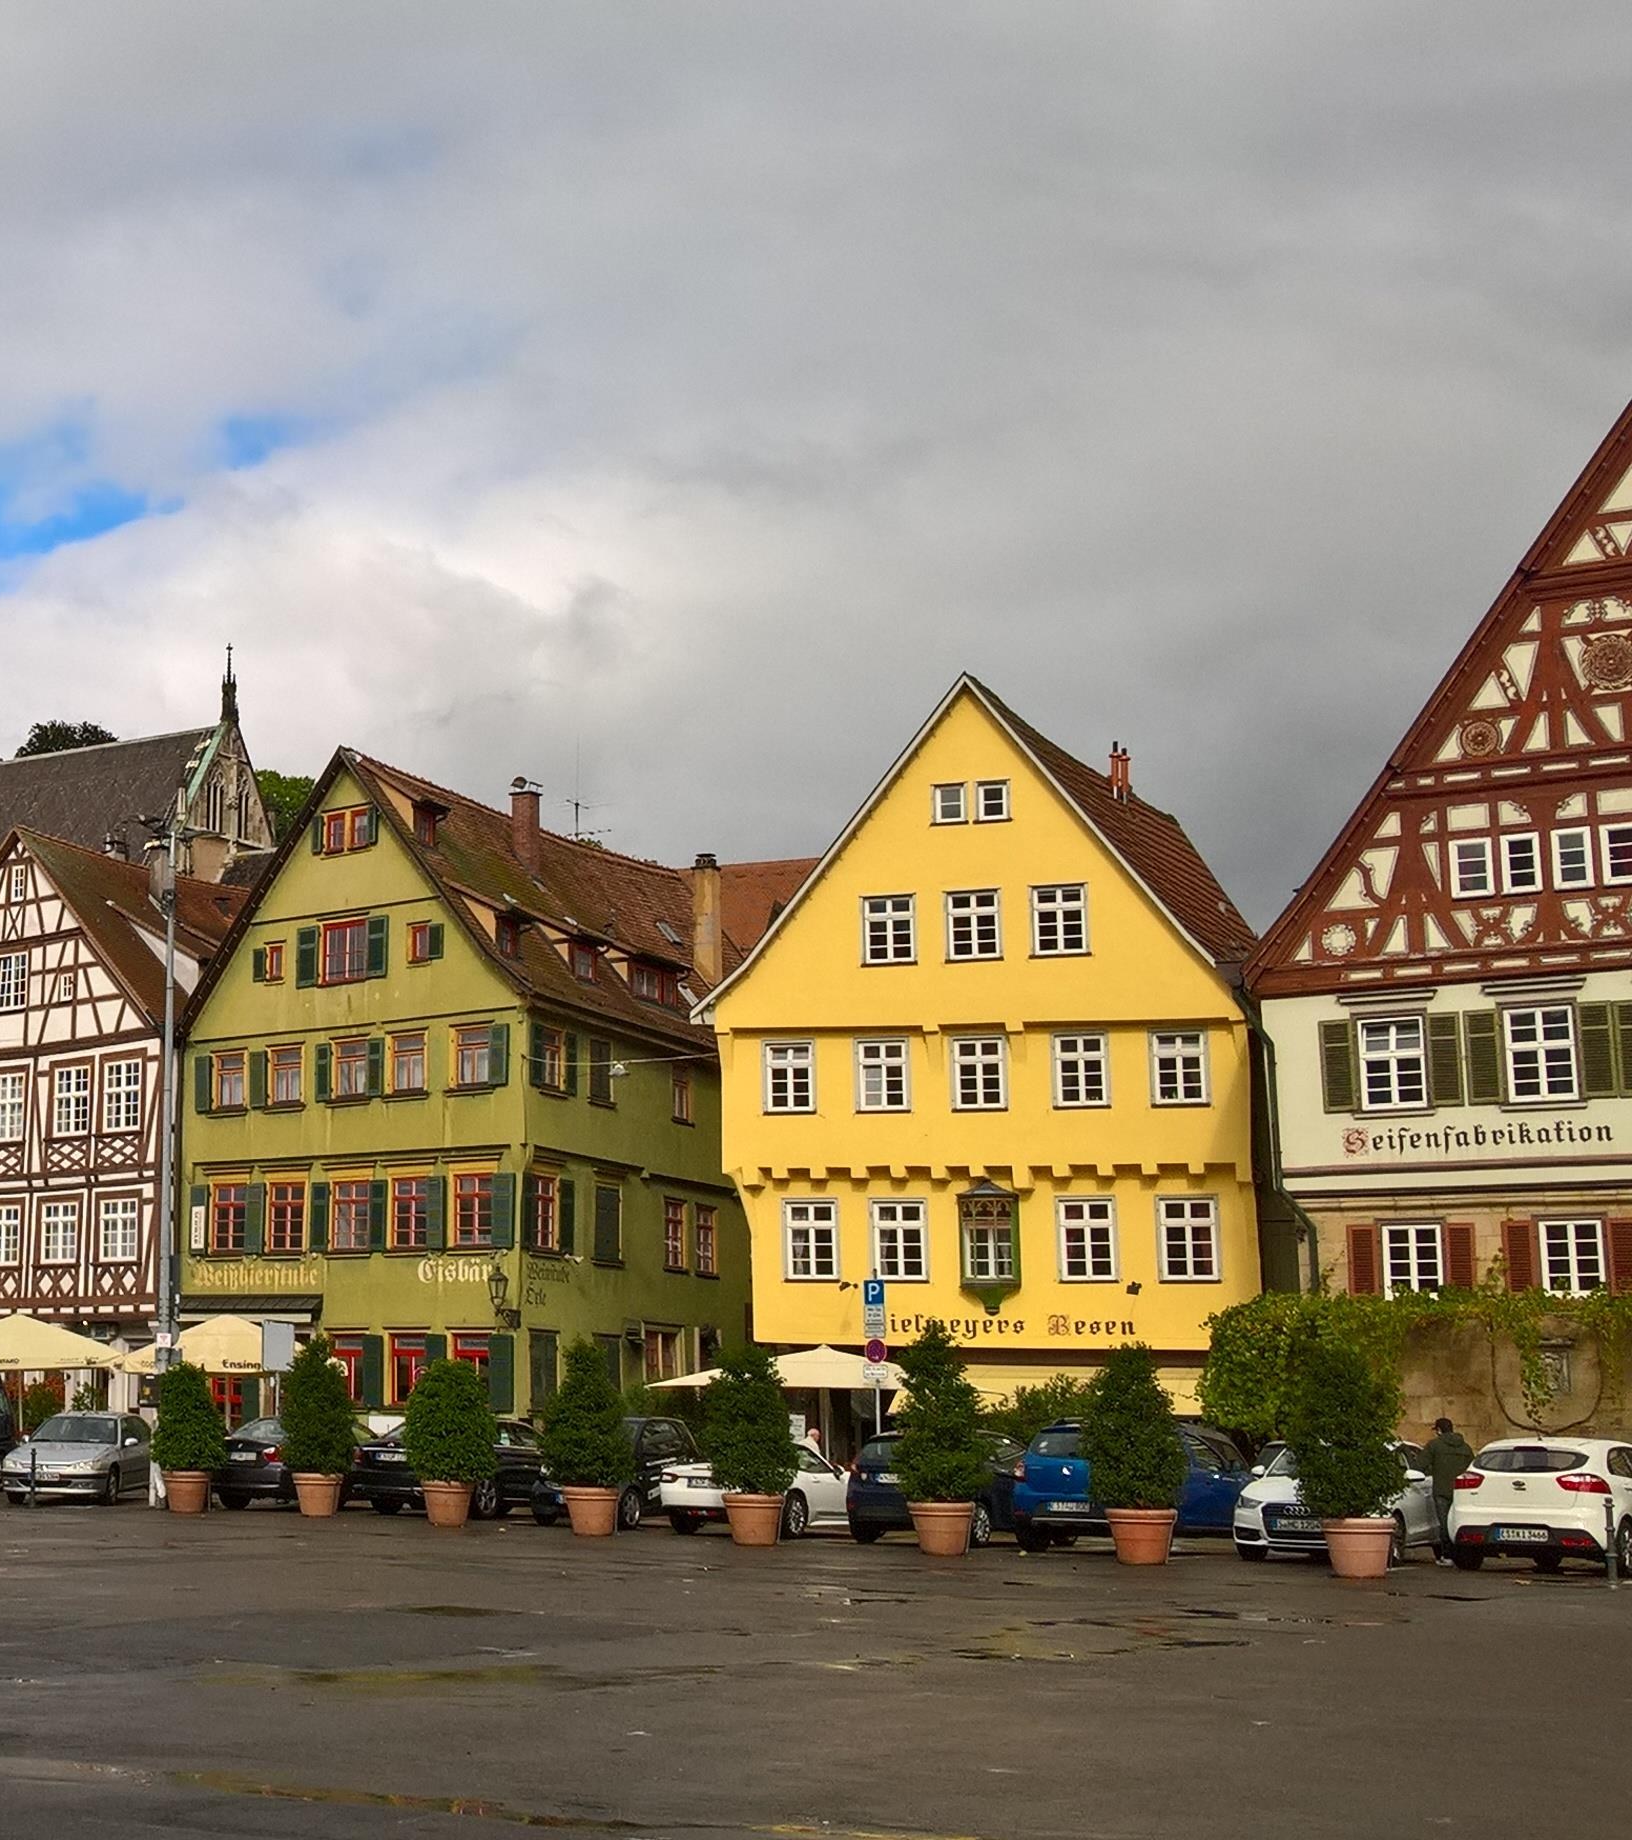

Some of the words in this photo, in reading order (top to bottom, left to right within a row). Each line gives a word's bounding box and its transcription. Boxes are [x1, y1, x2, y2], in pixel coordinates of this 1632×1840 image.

[1342, 1119, 1615, 1158] Seifenfabrikation
[868, 1282, 881, 1302] P
[221, 1358, 262, 1370] Ensing
